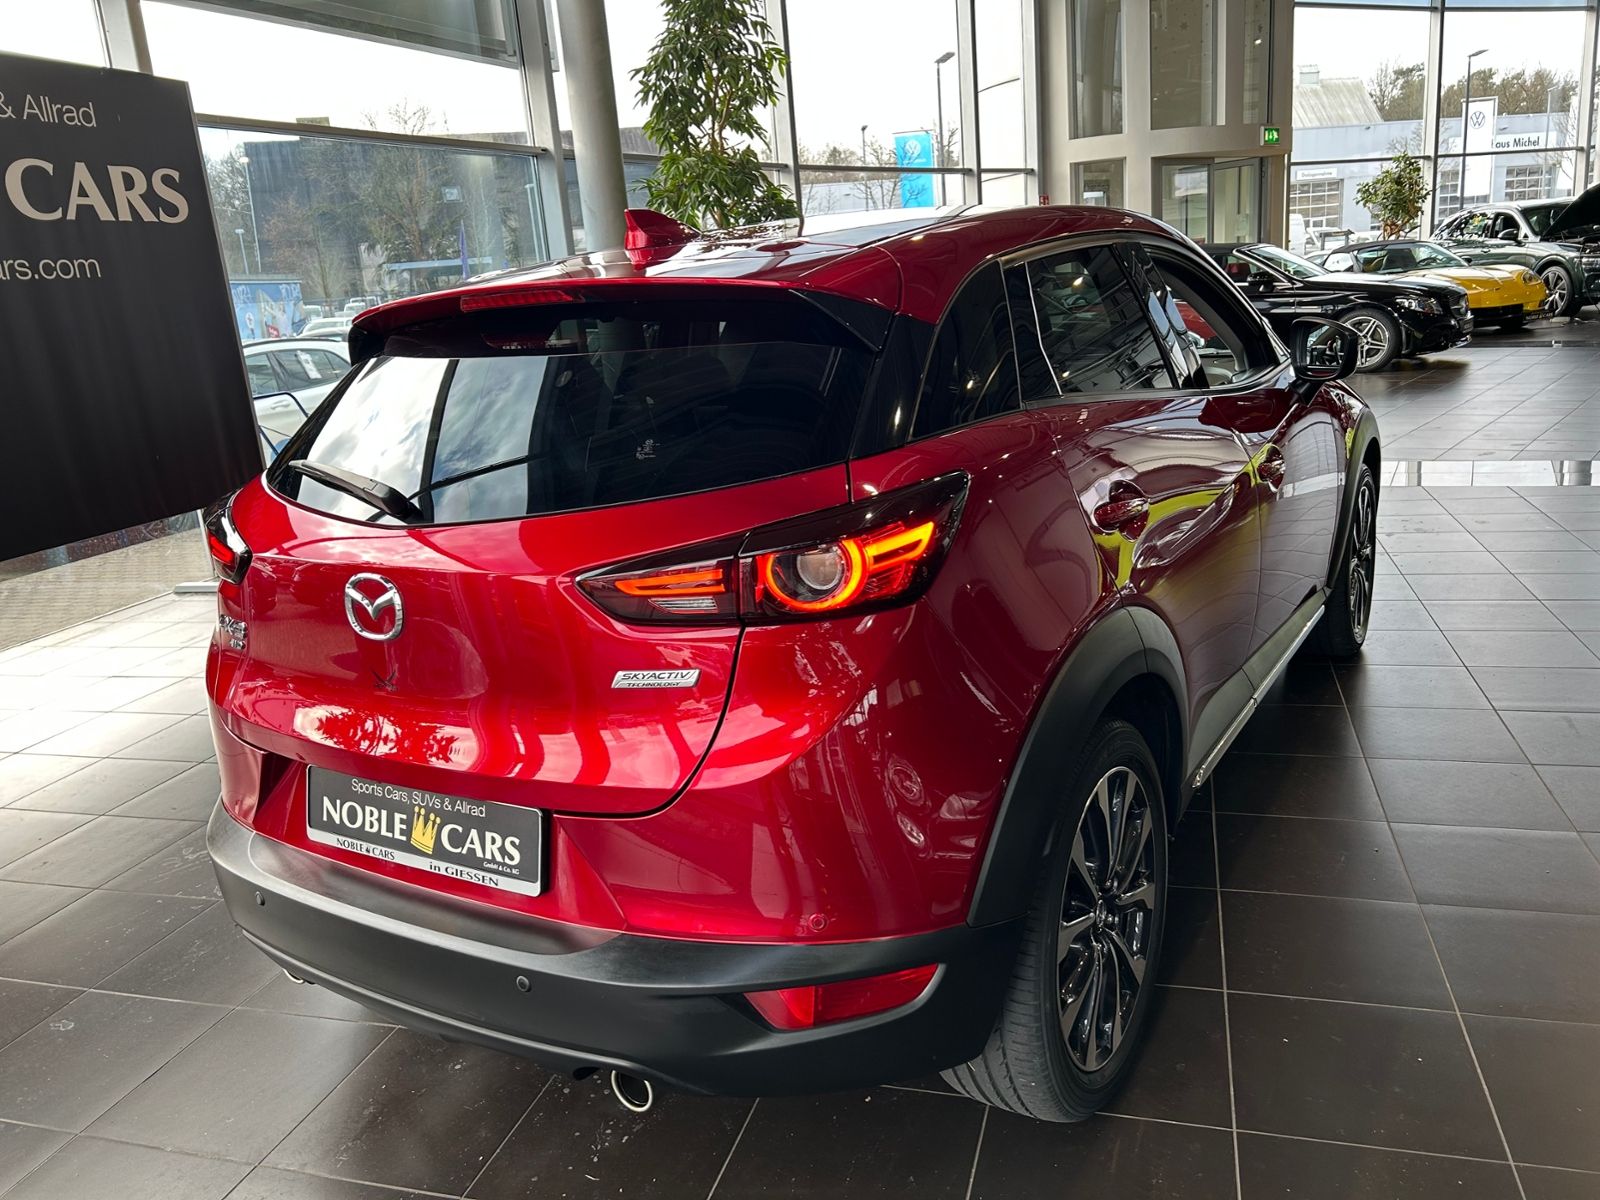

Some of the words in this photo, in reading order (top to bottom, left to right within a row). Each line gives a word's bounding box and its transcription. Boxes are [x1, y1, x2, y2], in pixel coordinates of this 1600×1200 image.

[23, 94, 97, 127] Allrad
[1513, 136, 1540, 148] Michel
[5, 158, 189, 224] CARS
[621, 671, 691, 680] SKYACTIV
[351, 778, 383, 797] Sports
[384, 785, 410, 804] Cars,
[412, 791, 441, 809] SUVs
[443, 797, 452, 811] &
[454, 800, 486, 817] Allrad
[322, 796, 407, 841] NOBLE
[441, 824, 520, 866] CARS
[336, 838, 364, 852] NOBLE
[372, 847, 395, 860] CARS
[429, 861, 441, 872] in
[445, 865, 499, 886] GIESSEN
